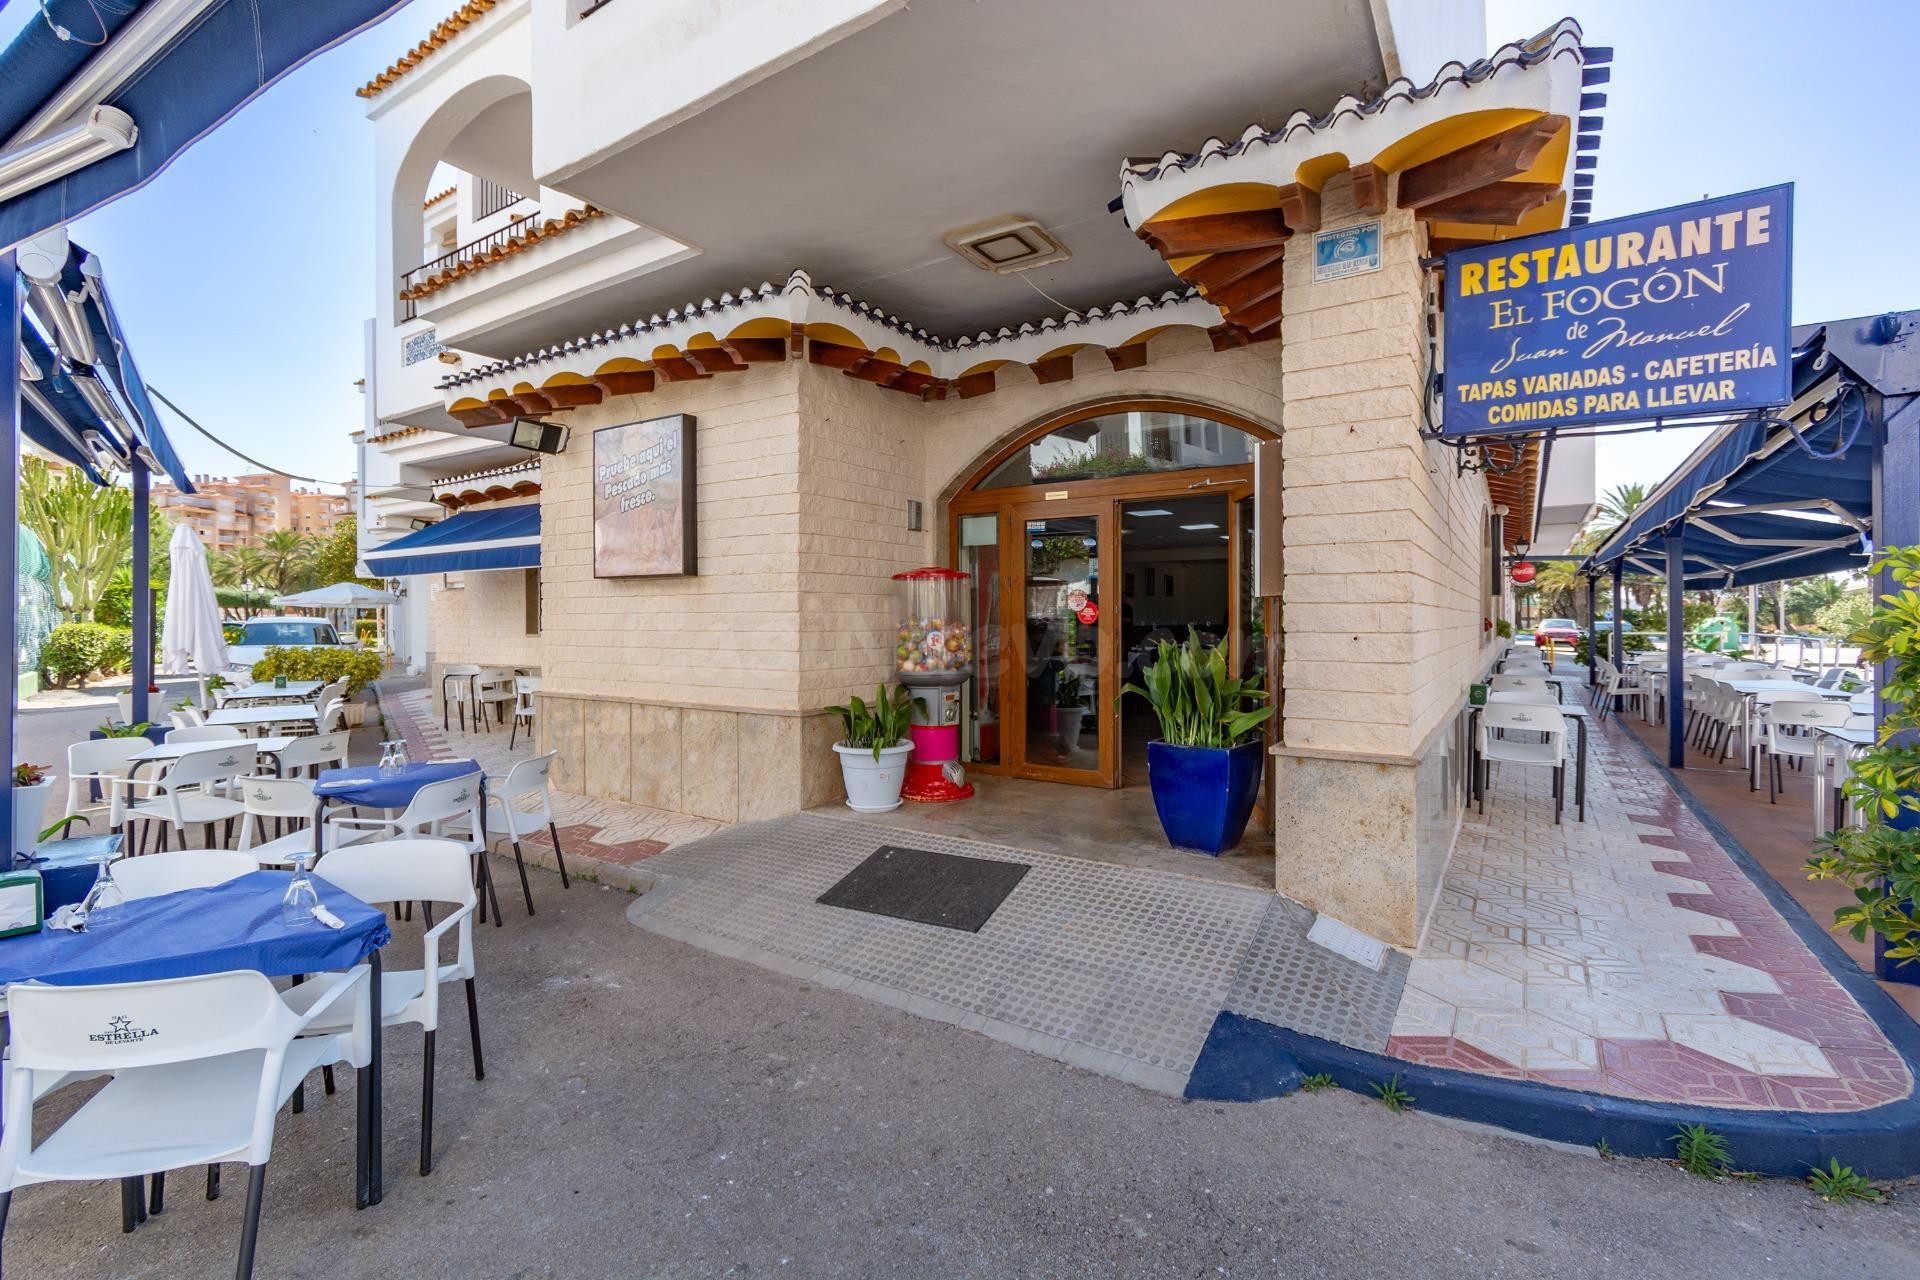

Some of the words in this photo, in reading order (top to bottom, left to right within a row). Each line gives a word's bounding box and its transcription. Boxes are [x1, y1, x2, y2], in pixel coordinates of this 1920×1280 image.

[1317, 229, 1360, 242] PROTEGIDO
[1361, 224, 1377, 233] POR
[1460, 205, 1771, 297] RESTAURANTE
[1489, 298, 1533, 329] EL
[1542, 262, 1729, 321] FOGÓN
[1489, 337, 1568, 374] Juan
[1582, 302, 1751, 359] Manuel
[1566, 320, 1589, 341] de
[1458, 378, 1517, 402] TAPAS
[1523, 366, 1626, 395] VARIADAS
[1645, 343, 1777, 381] CAFETERÍA
[1488, 398, 1578, 425] COMIDAS
[1584, 388, 1639, 414] PARA
[1647, 379, 1735, 408] LLEVAR
[599, 453, 637, 481] Pruebe
[666, 430, 678, 451] el
[604, 470, 647, 499] Pescado
[620, 489, 656, 514] fresco.
[89, 1028, 160, 1042] ESTRELLA
